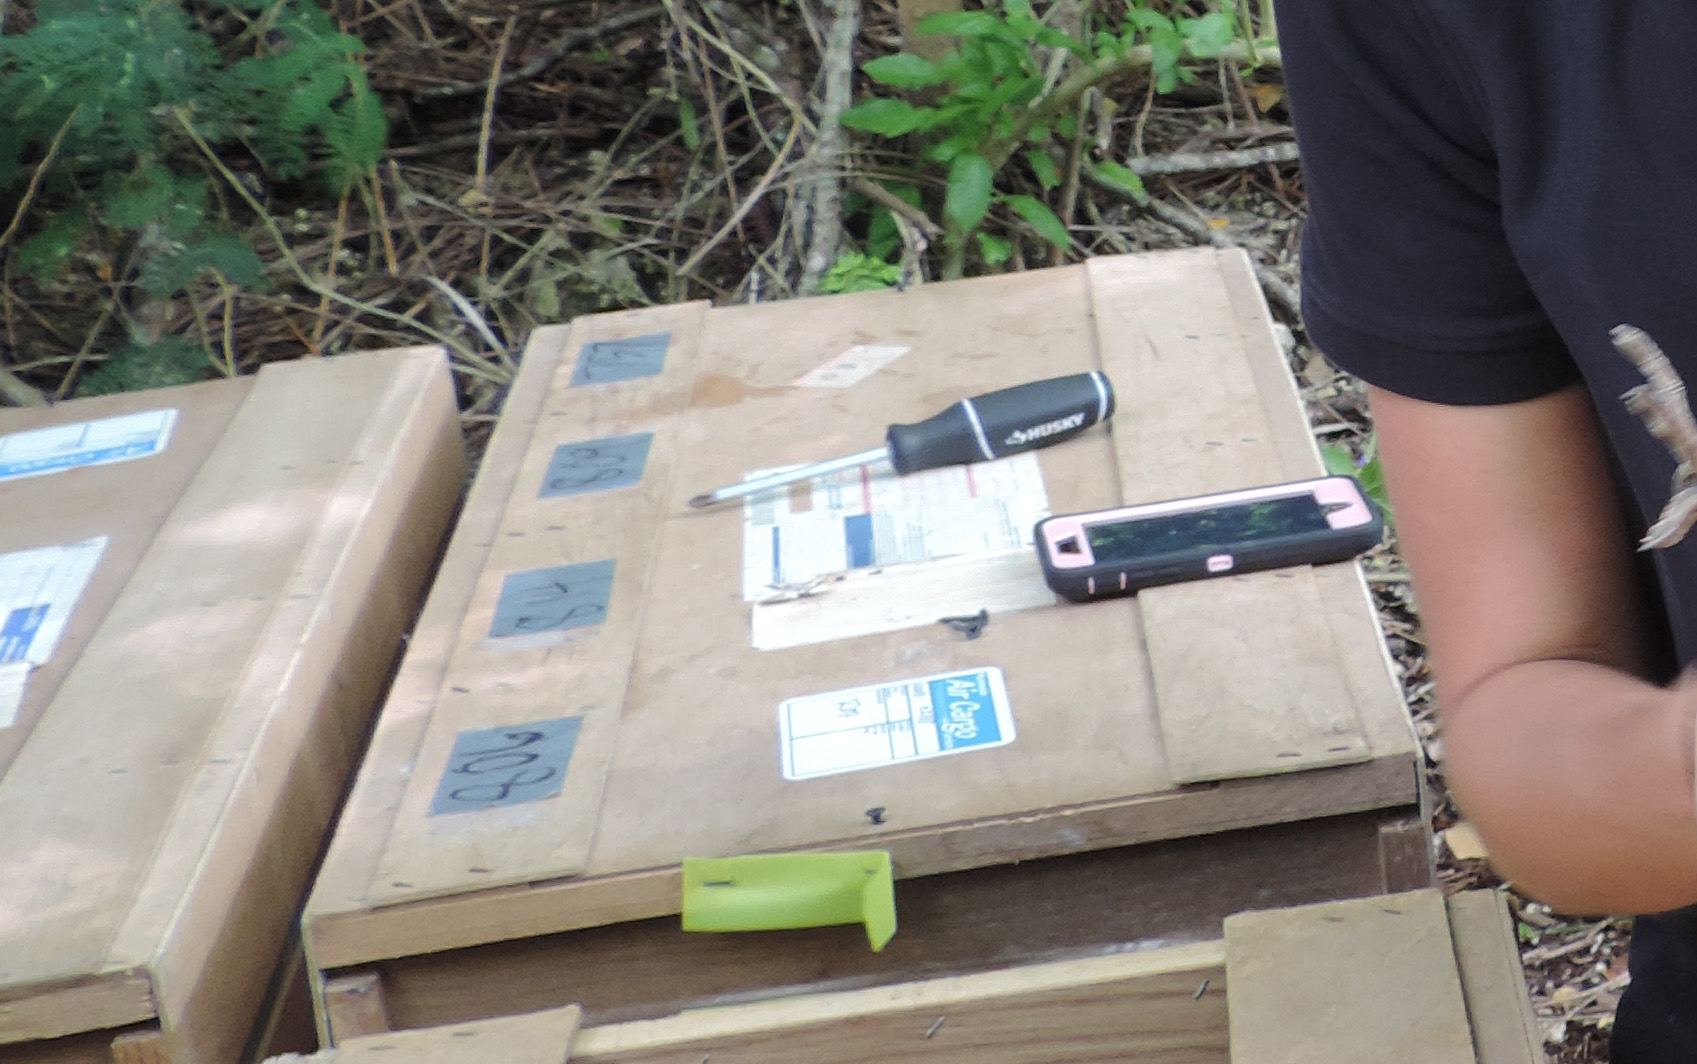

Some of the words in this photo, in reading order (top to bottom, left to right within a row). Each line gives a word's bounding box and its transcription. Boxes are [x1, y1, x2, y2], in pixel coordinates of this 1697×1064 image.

[1026, 411, 1086, 440] HUSKY
[945, 678, 977, 700] Air
[941, 700, 981, 739] Cargo
